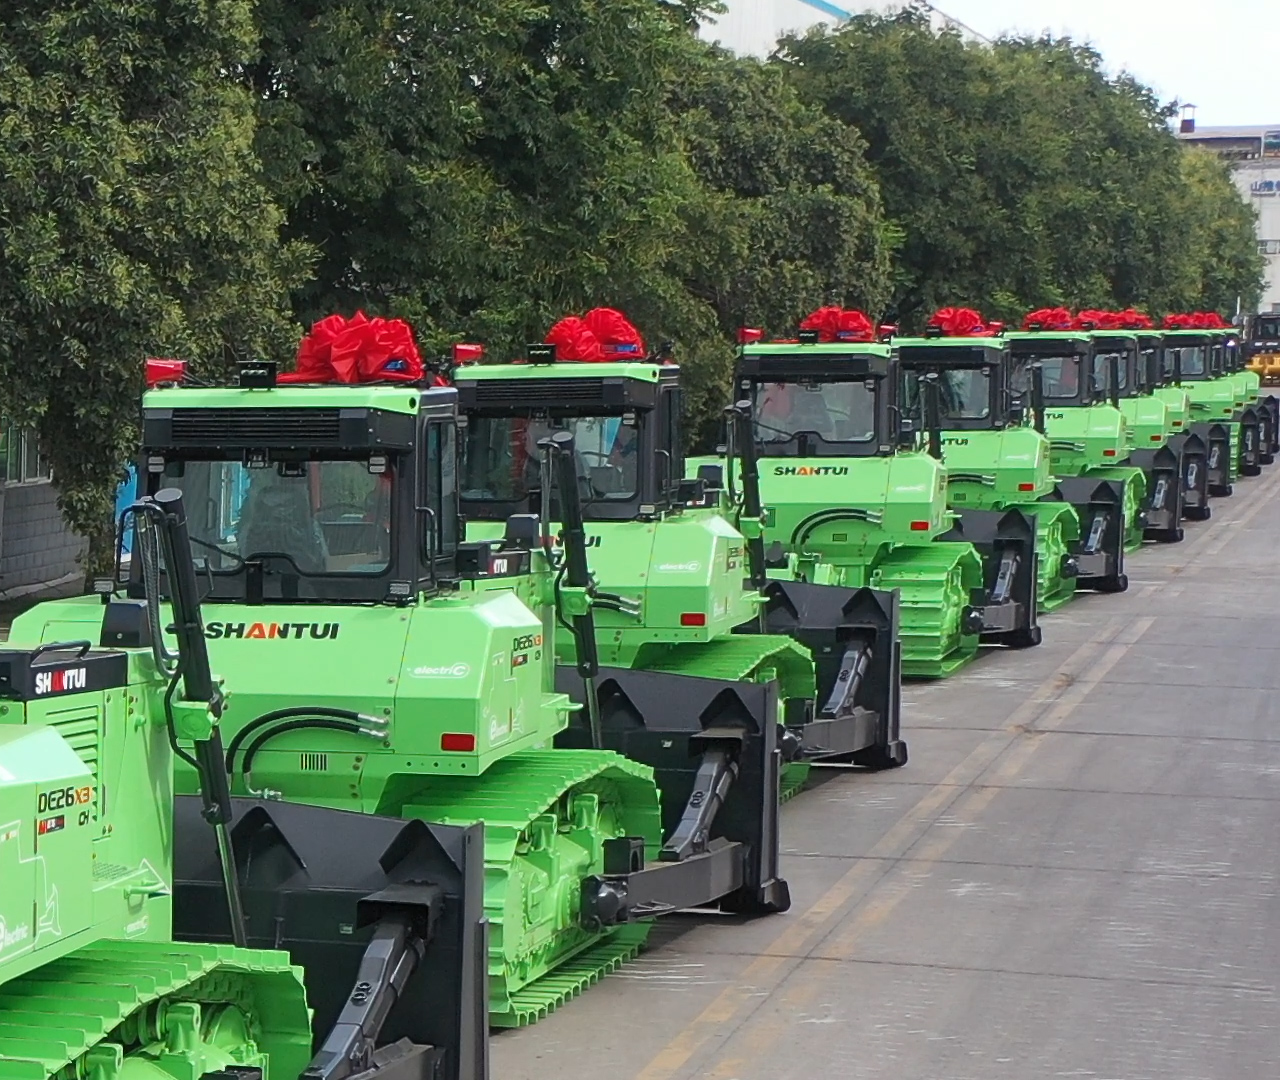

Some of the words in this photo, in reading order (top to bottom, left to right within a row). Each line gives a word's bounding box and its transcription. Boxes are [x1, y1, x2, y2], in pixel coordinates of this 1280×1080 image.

[774, 466, 849, 476] SHANTUI
[204, 622, 339, 640] SHANTUI
[34, 668, 87, 695] SHANTUI
[38, 786, 91, 813] DE26X3
